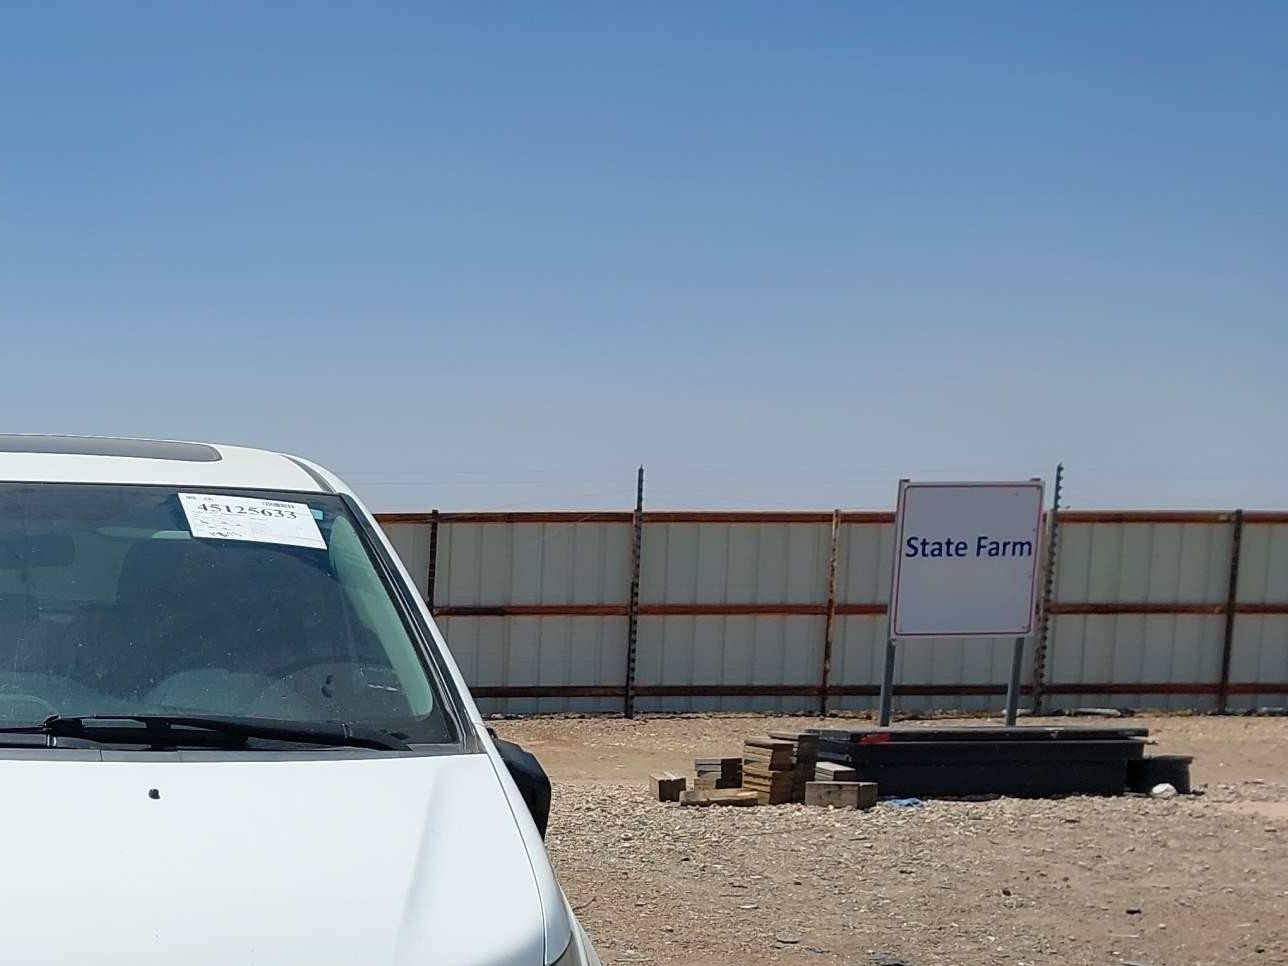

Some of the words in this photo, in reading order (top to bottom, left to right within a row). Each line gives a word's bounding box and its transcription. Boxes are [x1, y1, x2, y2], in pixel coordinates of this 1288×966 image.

[197, 502, 297, 520] 45125633
[905, 536, 968, 558] State
[976, 536, 1032, 557] Farm
